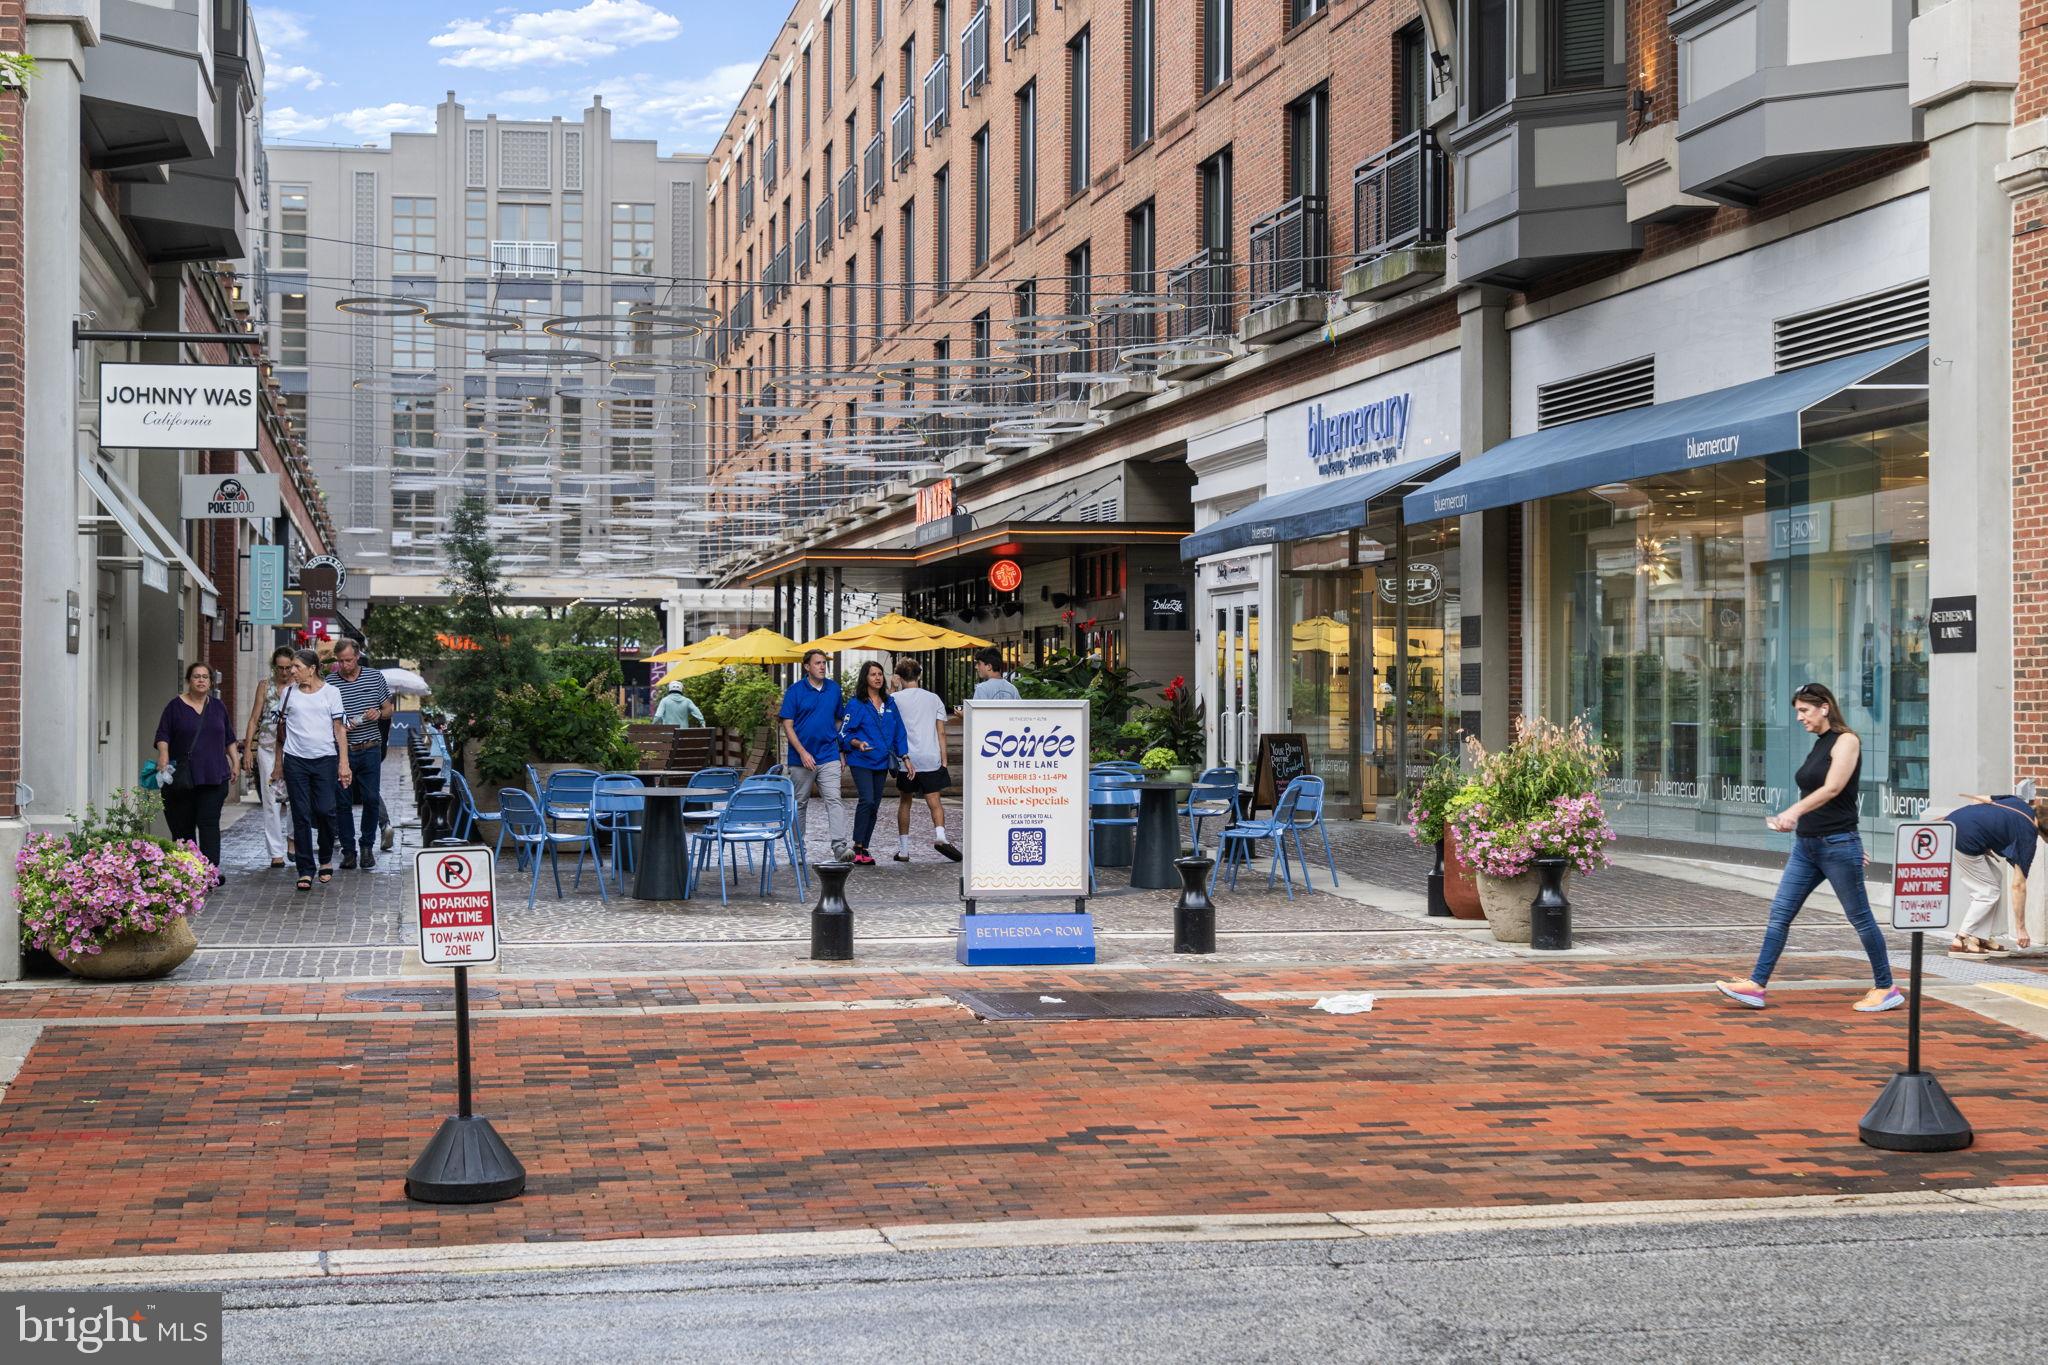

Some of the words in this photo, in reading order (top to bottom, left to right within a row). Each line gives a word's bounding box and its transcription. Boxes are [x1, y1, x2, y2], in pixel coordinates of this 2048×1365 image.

[106, 386, 198, 405] JOHNNY
[203, 388, 252, 406] WAS
[142, 411, 213, 431] California
[1307, 393, 1410, 457] bluemercury
[1686, 434, 1740, 459] bluemercury
[208, 502, 232, 514] POKE
[232, 501, 255, 513] DOJO
[1433, 493, 1468, 512] bluemercury
[1251, 523, 1276, 539] bluemercury
[261, 559, 273, 612] MORLEY
[316, 589, 333, 597] THE
[980, 725, 1076, 758] Soirée
[996, 761, 1009, 769] ON
[1013, 761, 1031, 769] THE
[1034, 761, 1059, 769] LANE
[987, 773, 1027, 781] SEPTEMBER
[1029, 773, 1037, 781] 13
[1042, 773, 1067, 781] 11-4PM
[998, 785, 1057, 797] Workshops
[1653, 773, 1709, 805] bluemercury
[1721, 777, 1782, 810] bluemercury
[986, 797, 1018, 806] Music
[1025, 796, 1069, 807] Specials
[1882, 787, 1930, 817] bluemer
[1897, 867, 1910, 878] NO
[1910, 867, 1949, 878] PARKING
[1901, 882, 1922, 892] ANY
[1922, 881, 1943, 892] TIME
[422, 898, 438, 910] NO
[439, 896, 489, 909] PARKING
[1900, 900, 1943, 910] TOW-AWAY
[430, 912, 455, 924] ANY
[456, 911, 483, 923] TIME
[1910, 912, 1931, 922] ZONE
[430, 931, 485, 943] TOW-AWAY
[976, 927, 1042, 938] BETHESDA
[1055, 926, 1083, 937] ROW
[445, 945, 472, 956] ZONE
